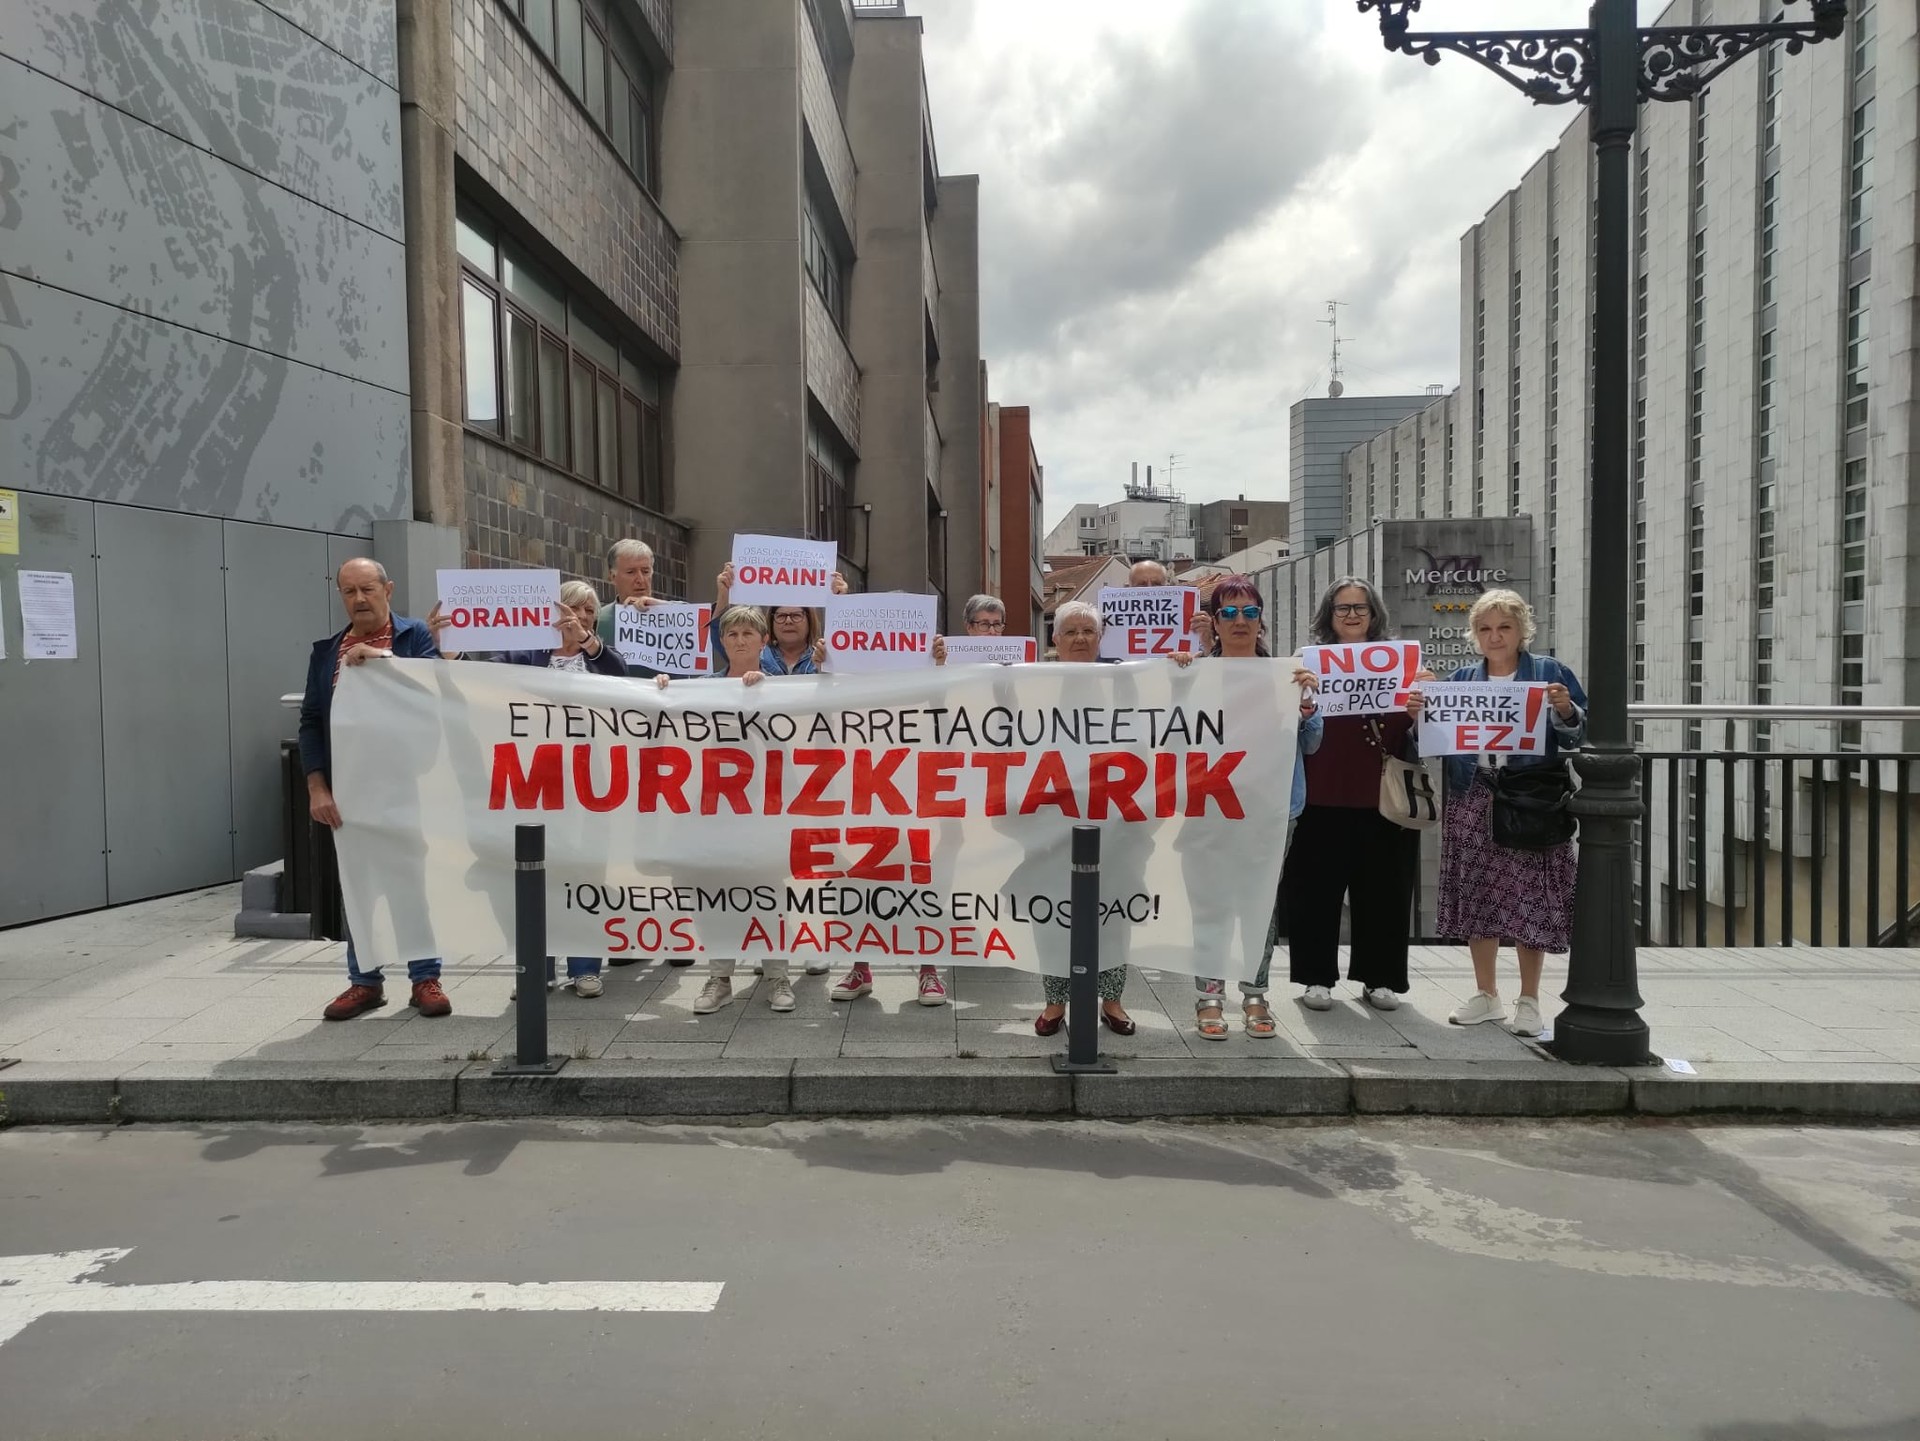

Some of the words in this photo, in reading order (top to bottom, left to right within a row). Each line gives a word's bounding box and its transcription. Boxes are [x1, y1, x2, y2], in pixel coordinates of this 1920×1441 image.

[739, 566, 826, 586] ORAIN!
[1406, 568, 1507, 584] Mercure
[452, 585, 497, 595] OSASUN
[500, 585, 547, 594] SISTEMA
[447, 596, 494, 606] PUBLIKO
[497, 596, 516, 605] ETA
[518, 596, 552, 605] DUINA
[1102, 599, 1178, 613] MURRIZ-
[450, 607, 550, 628] ORAIN!
[619, 610, 694, 628] QUEREMOS
[837, 608, 877, 618] OSASUN
[879, 609, 924, 619] SISTEMA
[1103, 613, 1179, 627] KETARIK
[832, 620, 873, 629] PUBLIKO
[875, 620, 895, 629] ETA
[896, 621, 928, 630] DUINA
[1429, 627, 1471, 639] HOT
[619, 626, 694, 650] MÉDICXS
[831, 630, 926, 652] ORAIN!
[946, 645, 993, 653] ETENGABEKO
[622, 652, 635, 660] en
[639, 652, 652, 663] los
[656, 652, 690, 669] PAC
[1327, 702, 1344, 713] los
[1349, 692, 1390, 711] PAC
[1424, 695, 1520, 709] MURRIZ-
[509, 702, 797, 742] ETENGABEKO
[1424, 710, 1520, 723] KETARIK
[488, 742, 1247, 822] MURRIZKETARIK
[789, 825, 932, 885] EZ!
[786, 880, 943, 921] MÉDICXS
[952, 893, 999, 921] EN
[1011, 893, 1072, 929] LOS
[604, 917, 705, 952] S.O.S.
